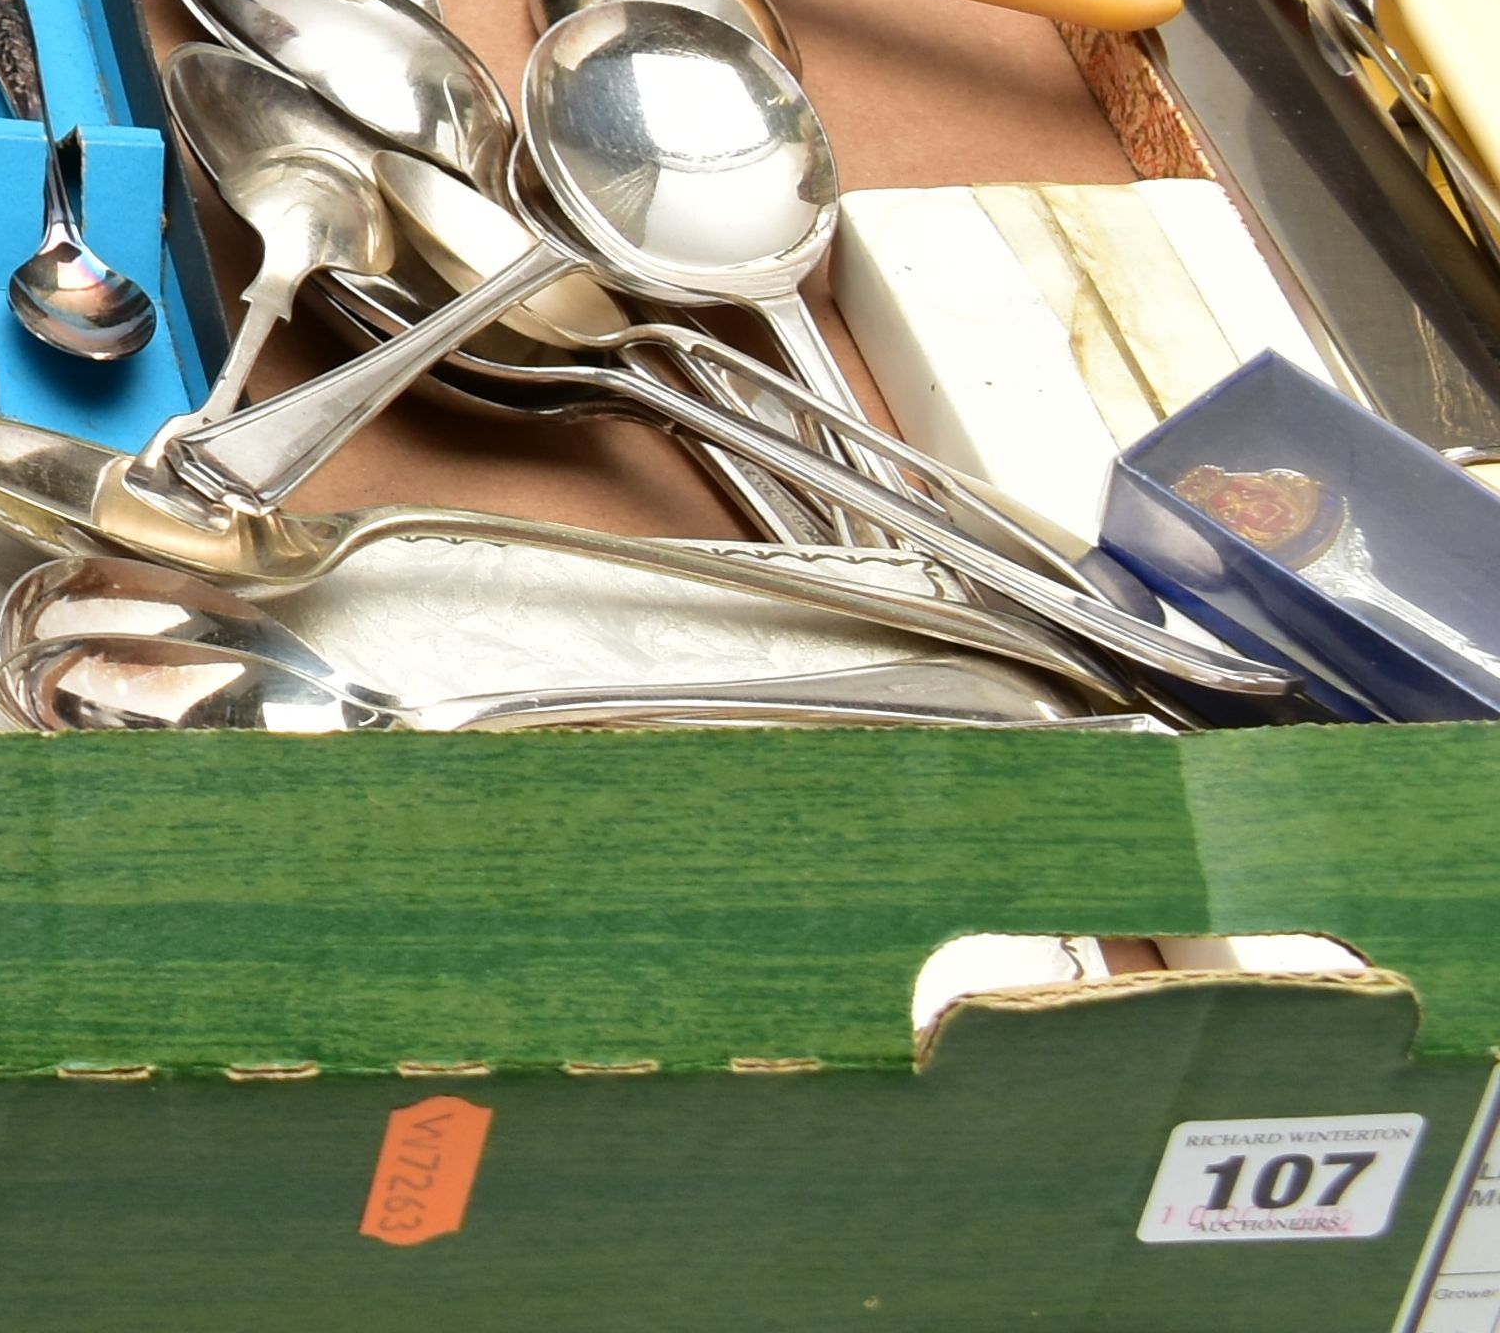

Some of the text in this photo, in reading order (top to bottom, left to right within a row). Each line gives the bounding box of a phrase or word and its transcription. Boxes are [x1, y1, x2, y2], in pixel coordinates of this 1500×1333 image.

[1185, 1127, 1413, 1148] RICHARD WINTERTON
[380, 1111, 455, 1231] W7263
[1202, 1151, 1378, 1210] 107
[1192, 1213, 1341, 1234] AUCTIONEERS
